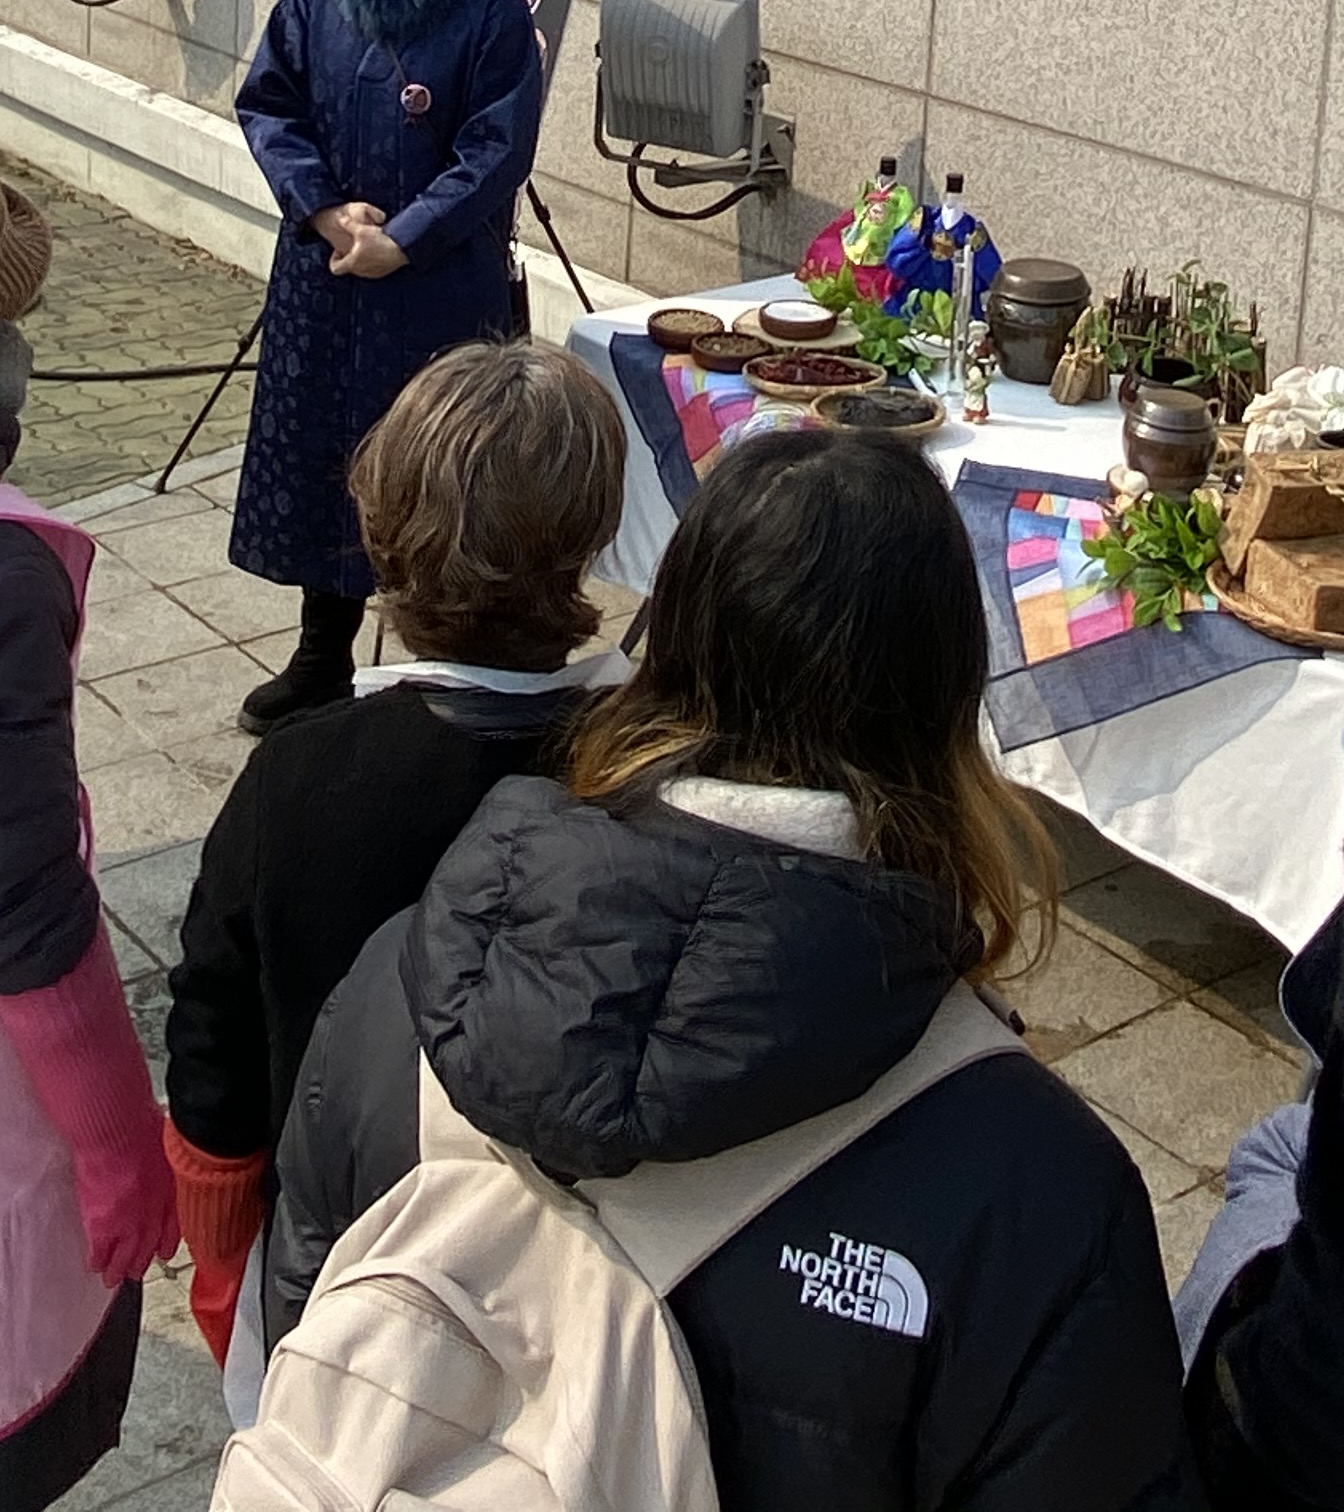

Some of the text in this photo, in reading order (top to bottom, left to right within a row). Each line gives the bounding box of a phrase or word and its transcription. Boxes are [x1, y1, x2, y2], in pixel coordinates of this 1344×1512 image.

[778, 1243, 879, 1298] NORTH
[828, 1230, 886, 1274] THE
[799, 1278, 876, 1325] FACE
